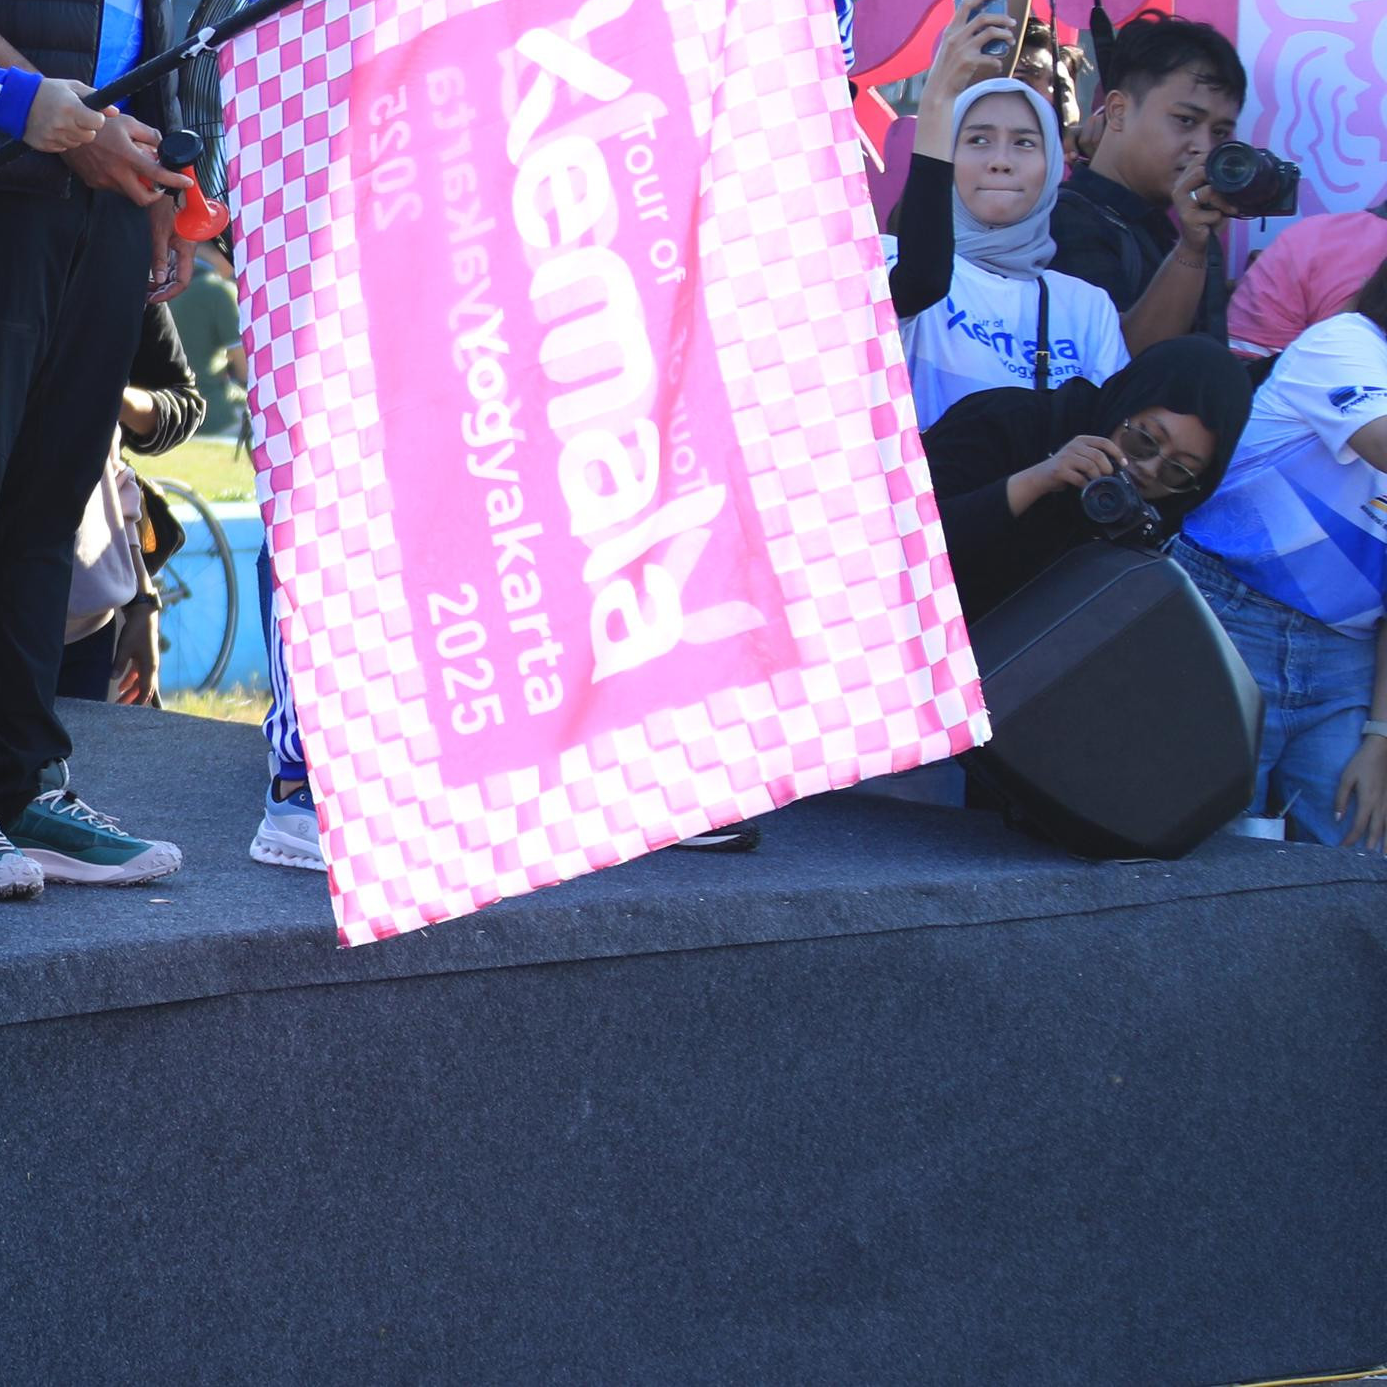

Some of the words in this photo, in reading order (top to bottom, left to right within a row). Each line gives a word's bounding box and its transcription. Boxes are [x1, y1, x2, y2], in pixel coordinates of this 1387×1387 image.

[620, 112, 670, 222] Tour
[649, 238, 687, 285] of
[458, 308, 564, 716] Yogyakarta
[427, 582, 505, 736] 2025
